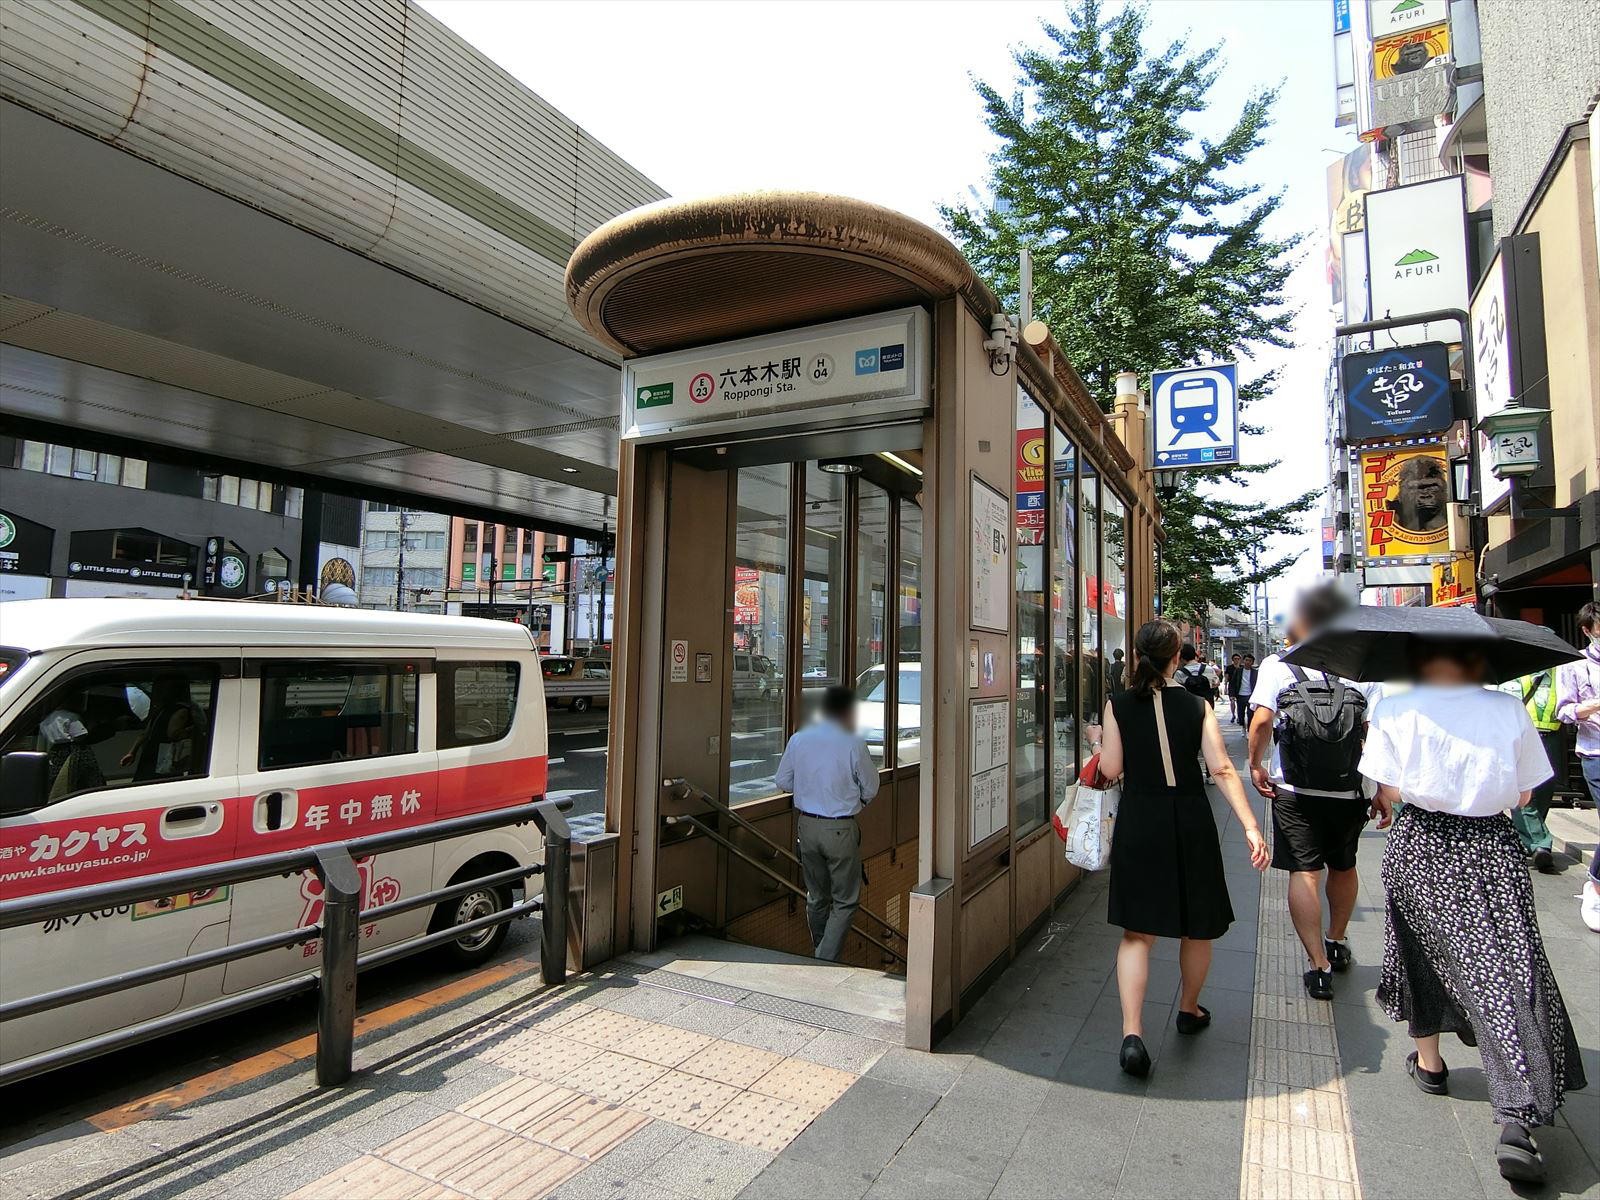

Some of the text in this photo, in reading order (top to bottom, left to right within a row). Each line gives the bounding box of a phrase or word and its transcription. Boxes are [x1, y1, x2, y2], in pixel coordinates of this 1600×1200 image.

[1391, 9, 1425, 23] AFURI
[1395, 264, 1440, 279] AFURI
[817, 358, 825, 368] H
[719, 357, 801, 389] 六本木駅
[813, 368, 828, 379] 04
[700, 378, 705, 387] E
[696, 387, 708, 397] 23
[724, 382, 796, 401] Roppongi Sta.
[106, 567, 129, 575] SHEEP
[304, 789, 421, 831] 年中無休
[29, 822, 147, 862] カクヤス
